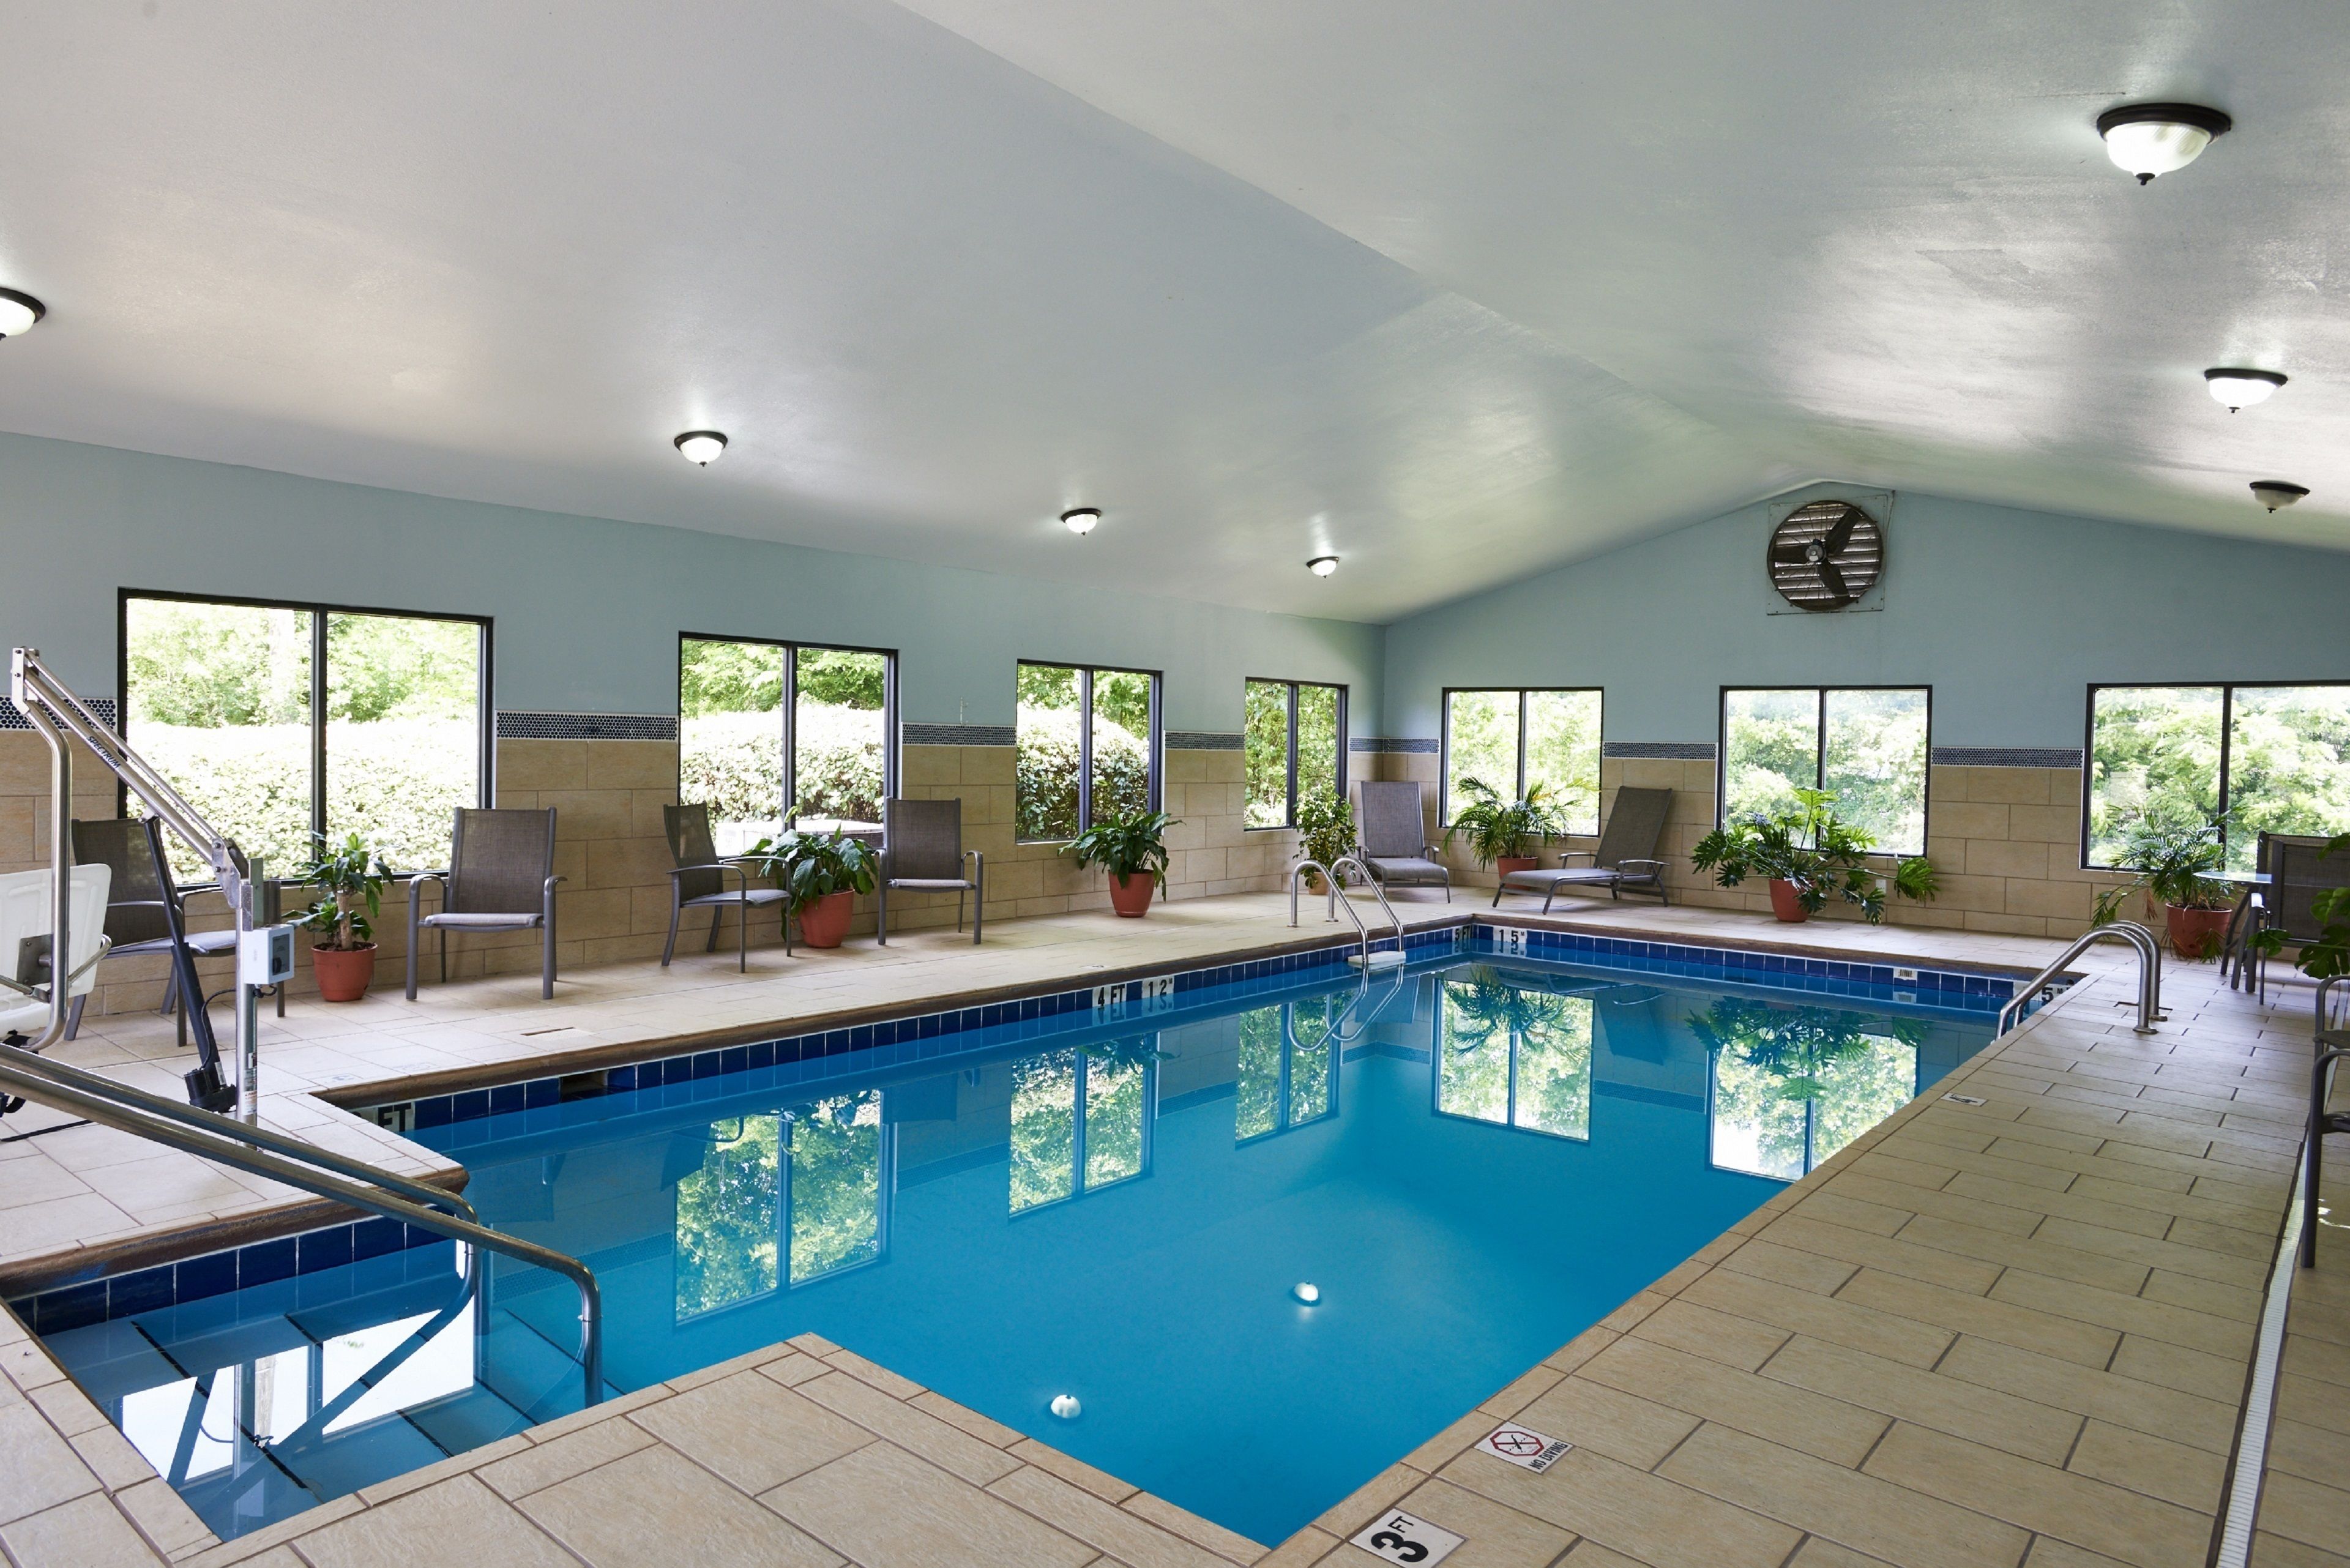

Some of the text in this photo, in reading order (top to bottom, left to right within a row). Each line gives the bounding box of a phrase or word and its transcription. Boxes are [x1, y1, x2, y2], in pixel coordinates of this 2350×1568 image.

[86, 736, 121, 768] SPECTRUM
[1098, 984, 1125, 1007] 4 FT
[1528, 1442, 1569, 1469] NO DIVING
[1371, 1515, 1429, 1562] 3 FT
